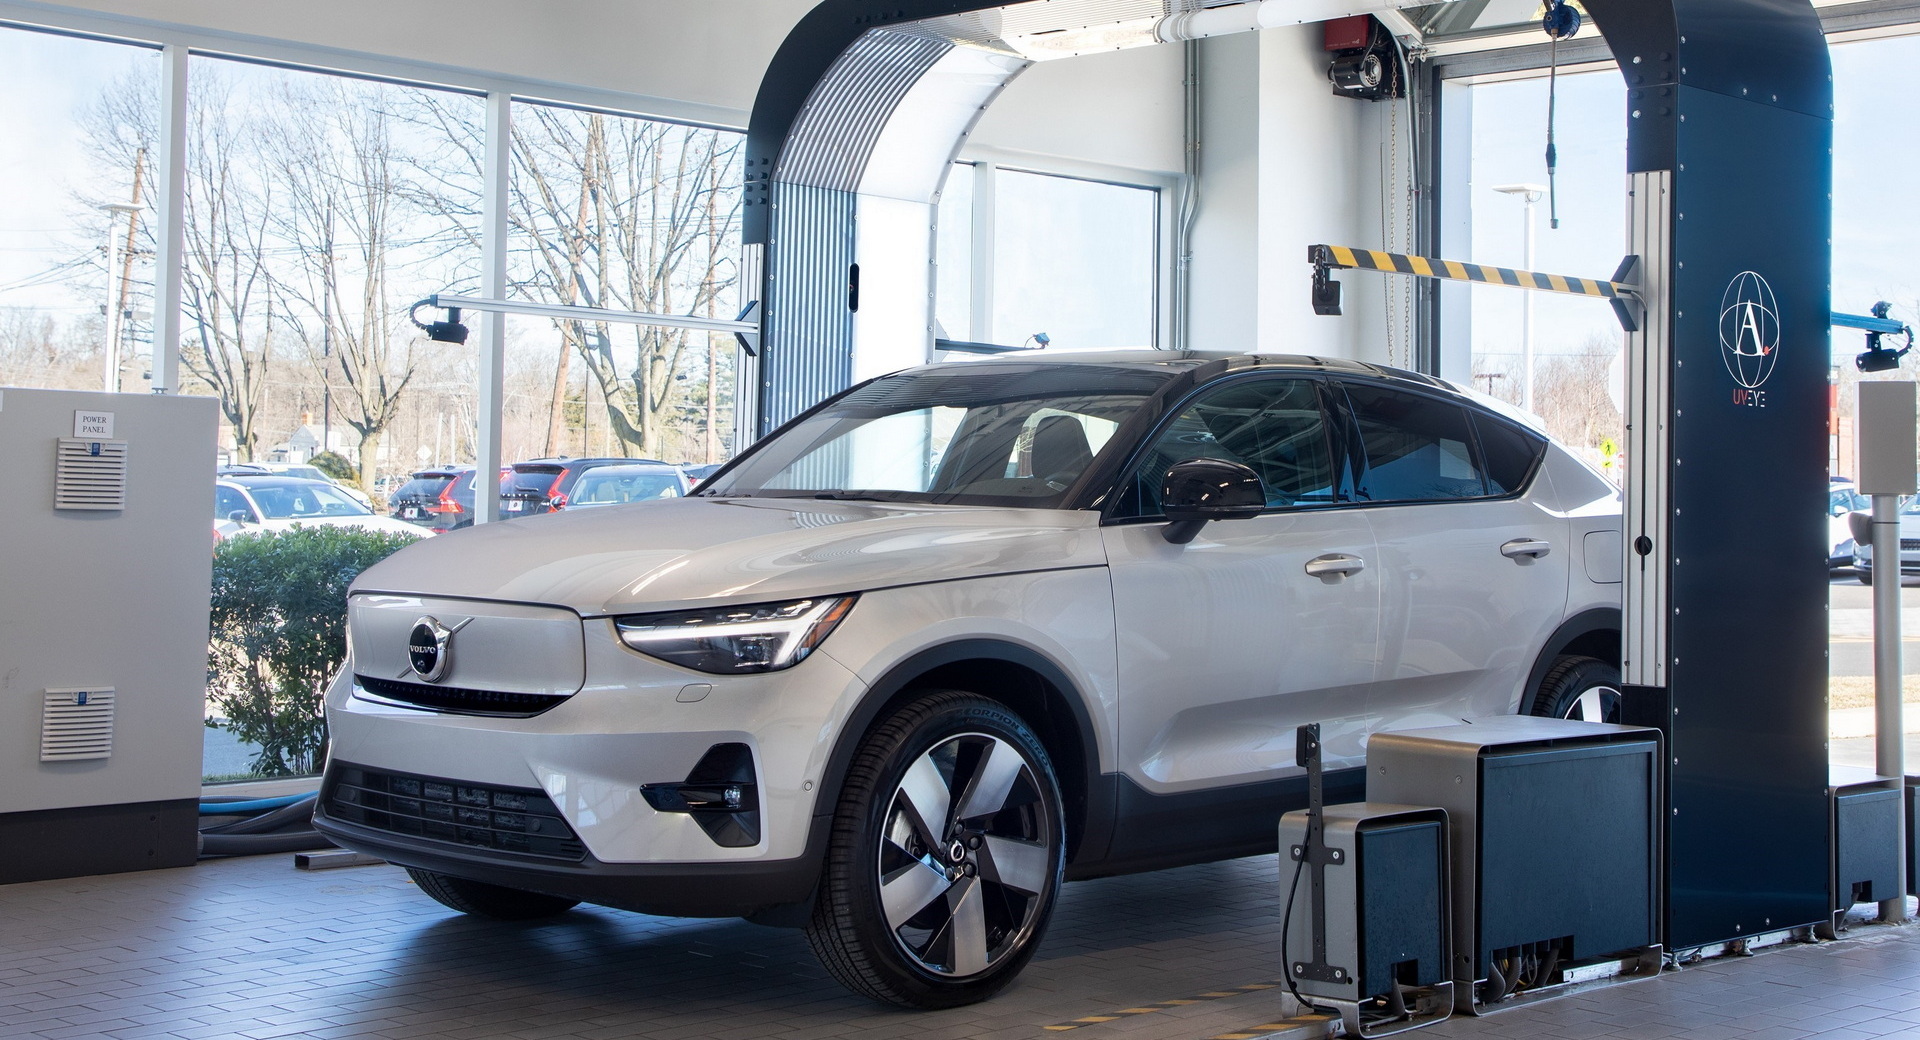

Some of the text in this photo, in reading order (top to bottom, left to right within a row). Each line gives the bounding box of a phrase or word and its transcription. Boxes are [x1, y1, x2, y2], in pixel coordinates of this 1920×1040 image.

[1732, 388, 1766, 407] UVEYE
[82, 415, 107, 424] POWER
[82, 425, 106, 434] PANEL
[410, 645, 436, 654] VOLVO
